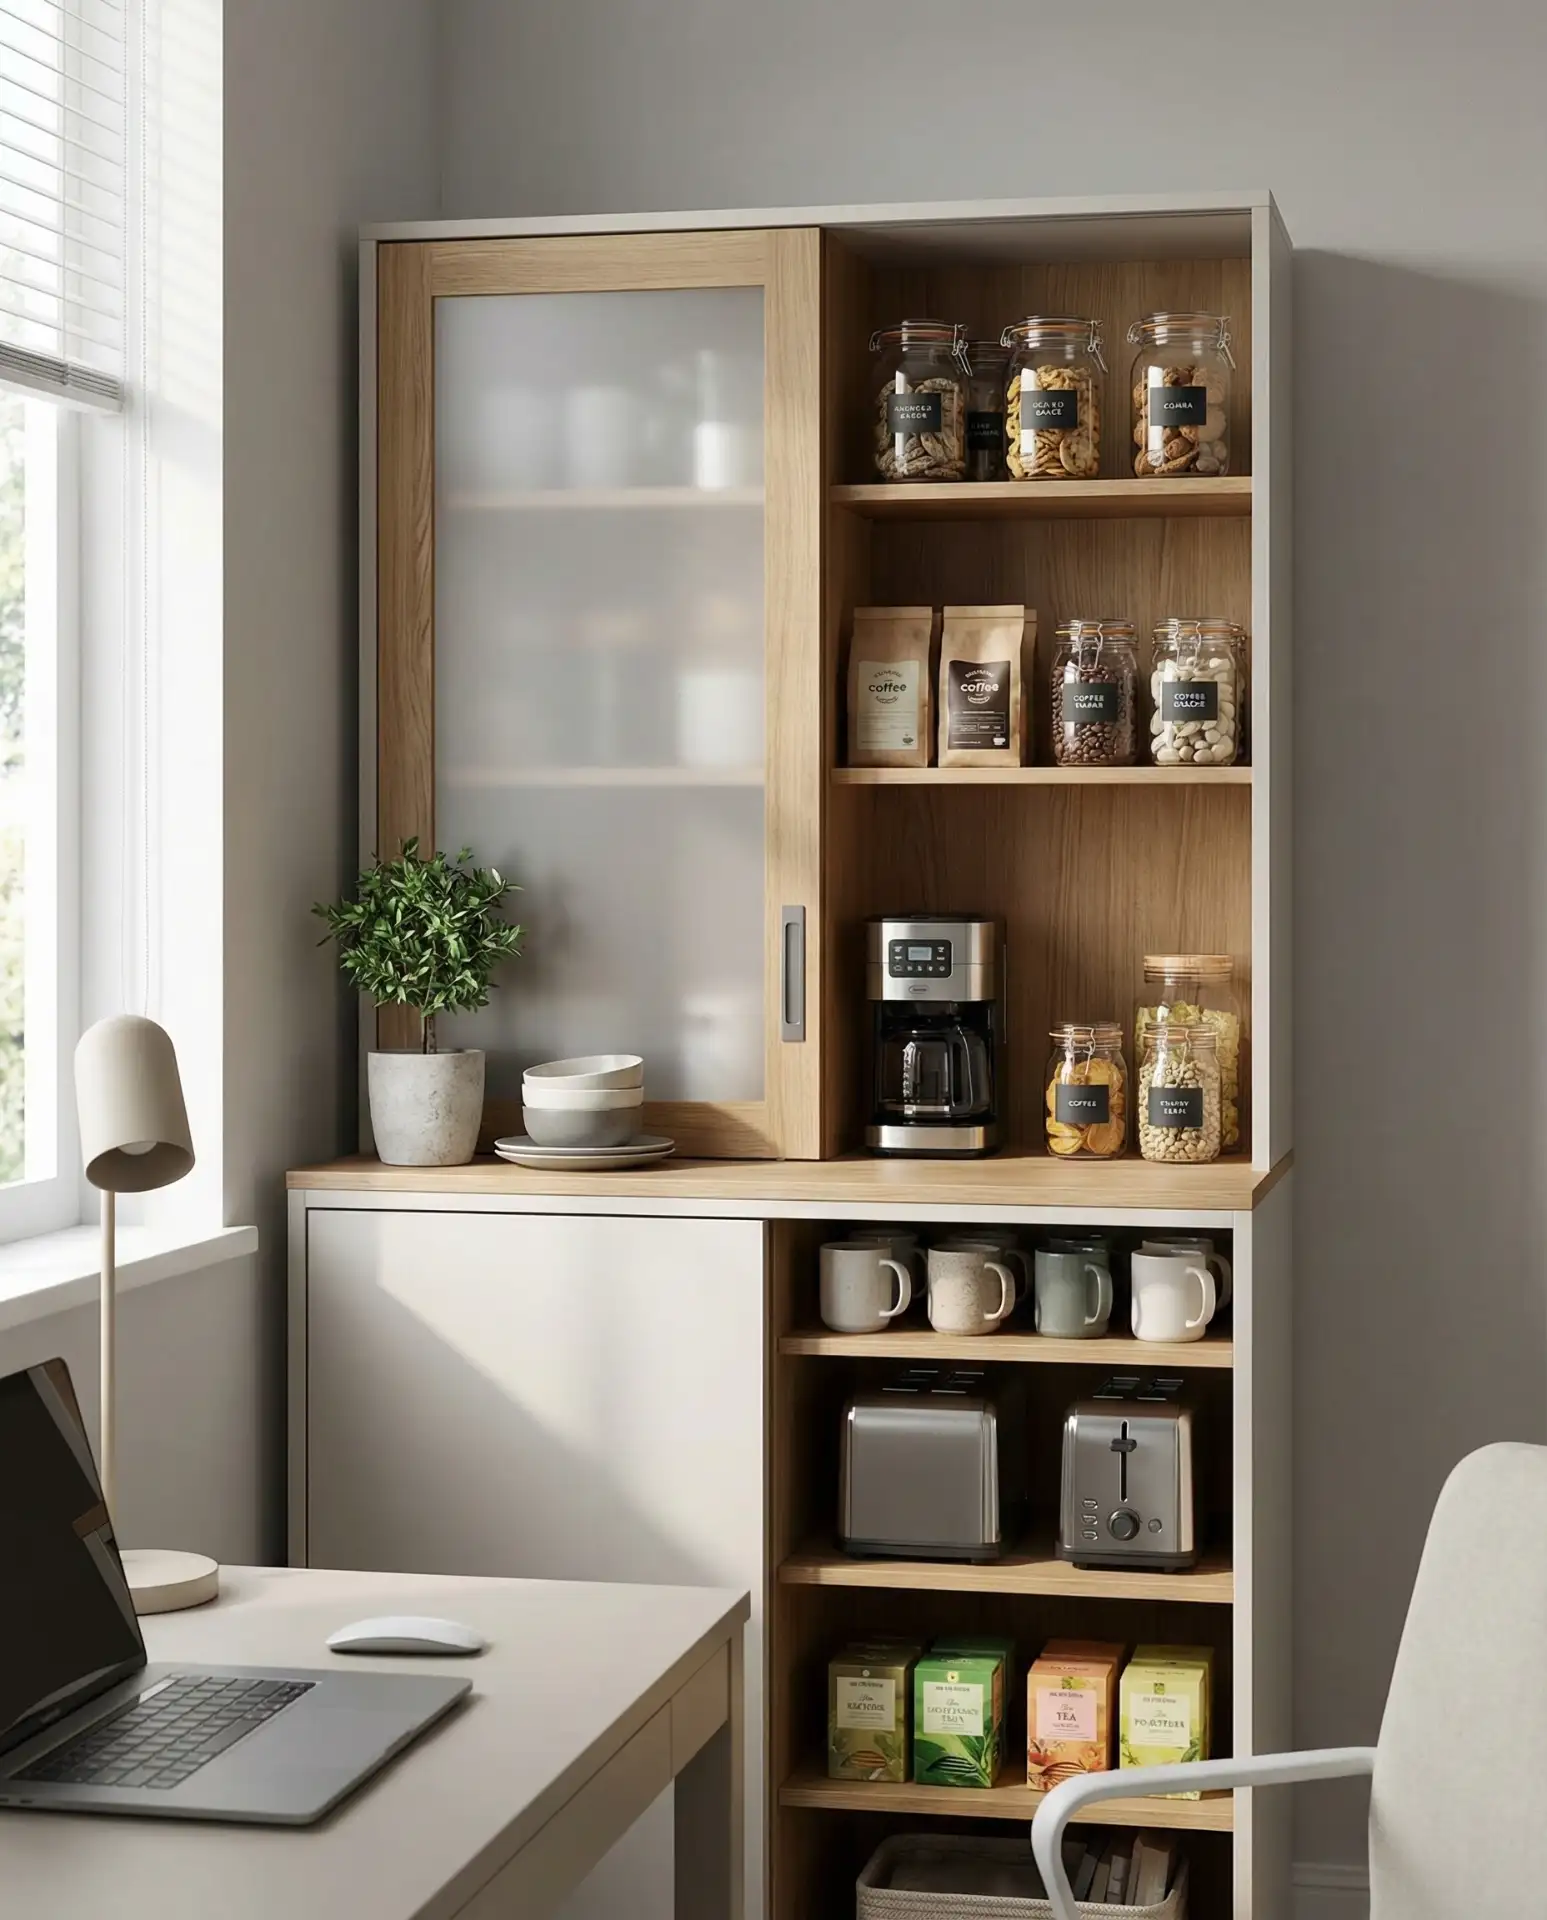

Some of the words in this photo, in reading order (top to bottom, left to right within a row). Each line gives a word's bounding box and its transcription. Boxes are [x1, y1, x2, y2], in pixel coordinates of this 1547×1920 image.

[868, 682, 907, 693] coffee
[960, 682, 999, 692] coffee
[1056, 1711, 1077, 1722] TEA
